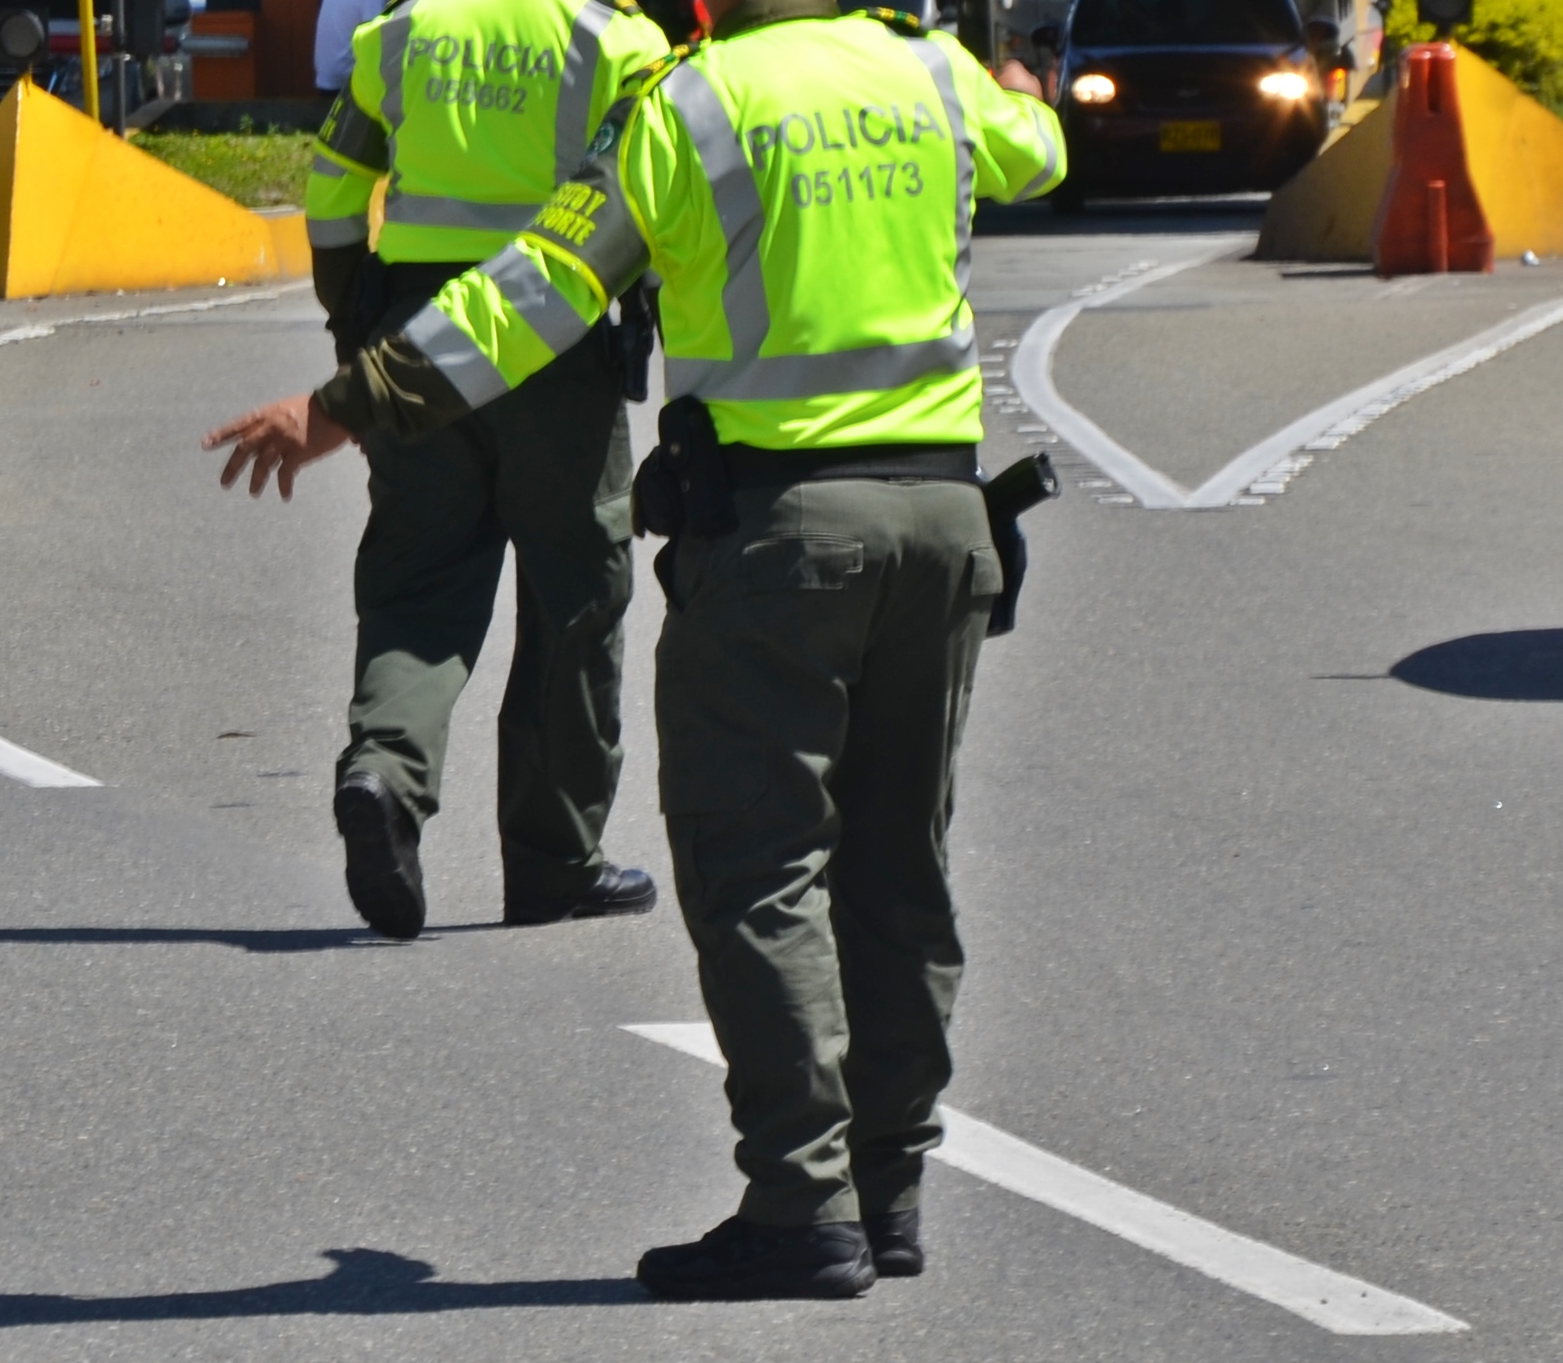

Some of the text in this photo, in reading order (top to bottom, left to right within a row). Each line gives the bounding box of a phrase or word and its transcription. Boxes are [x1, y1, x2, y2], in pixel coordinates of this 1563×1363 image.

[407, 35, 556, 81] POLICIA
[745, 100, 946, 172] POLICIA
[791, 161, 924, 209] 051173
